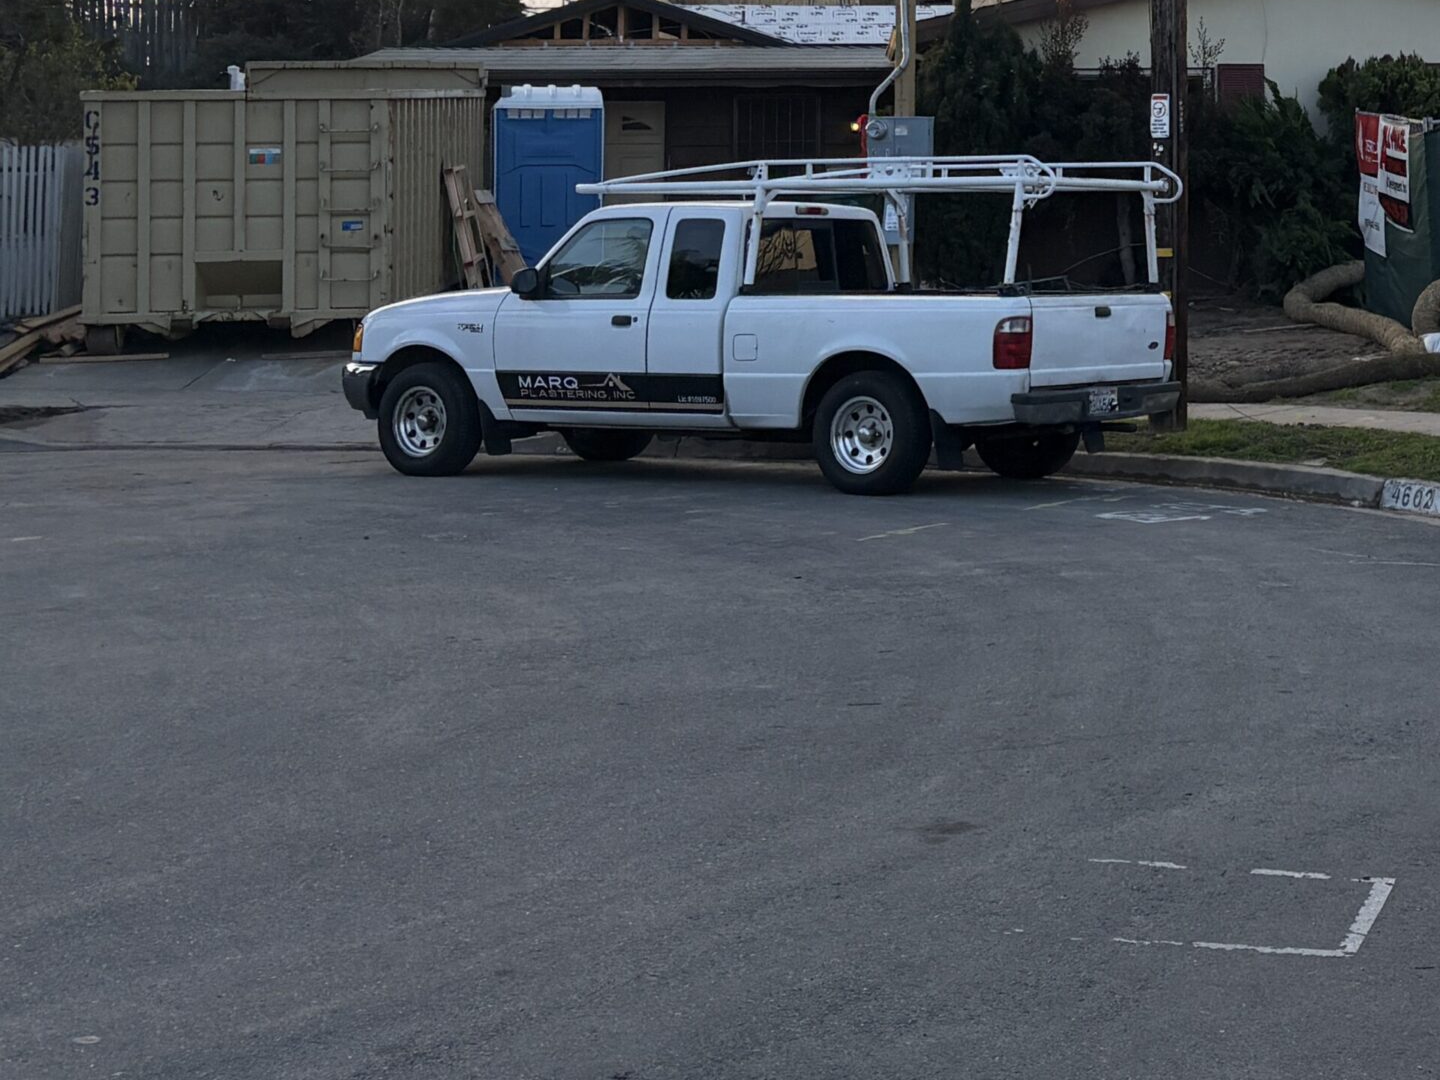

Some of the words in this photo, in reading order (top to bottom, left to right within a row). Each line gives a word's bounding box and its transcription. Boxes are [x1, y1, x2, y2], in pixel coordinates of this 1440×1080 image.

[518, 375, 579, 390] MARQ
[613, 390, 636, 400] INC
[1391, 485, 1435, 510] 4602
